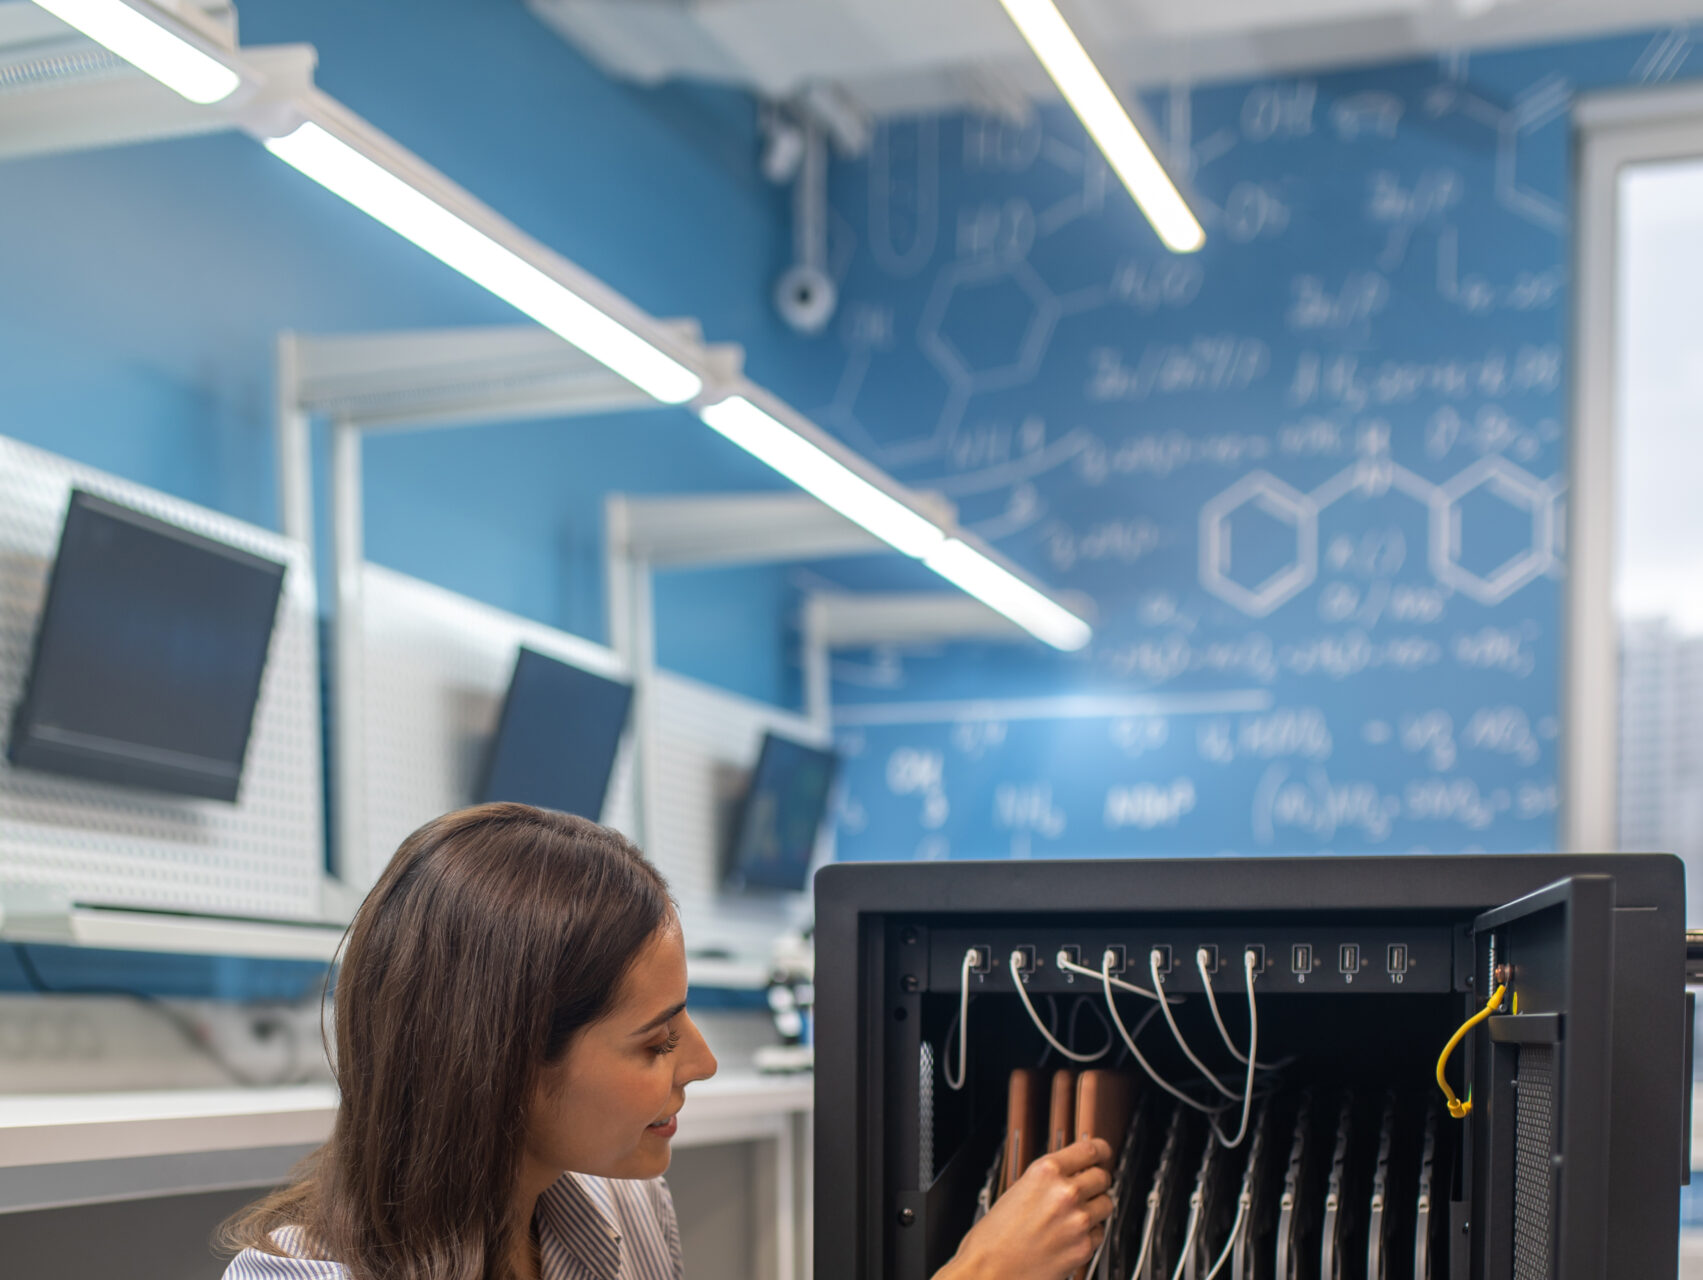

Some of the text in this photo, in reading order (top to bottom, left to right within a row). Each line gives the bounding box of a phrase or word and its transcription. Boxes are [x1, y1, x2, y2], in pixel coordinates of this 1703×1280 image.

[1022, 974, 1029, 984] 2
[1067, 974, 1074, 984] 3
[1298, 974, 1305, 984] 8
[1346, 974, 1353, 984] 9
[1391, 974, 1404, 984] 10
